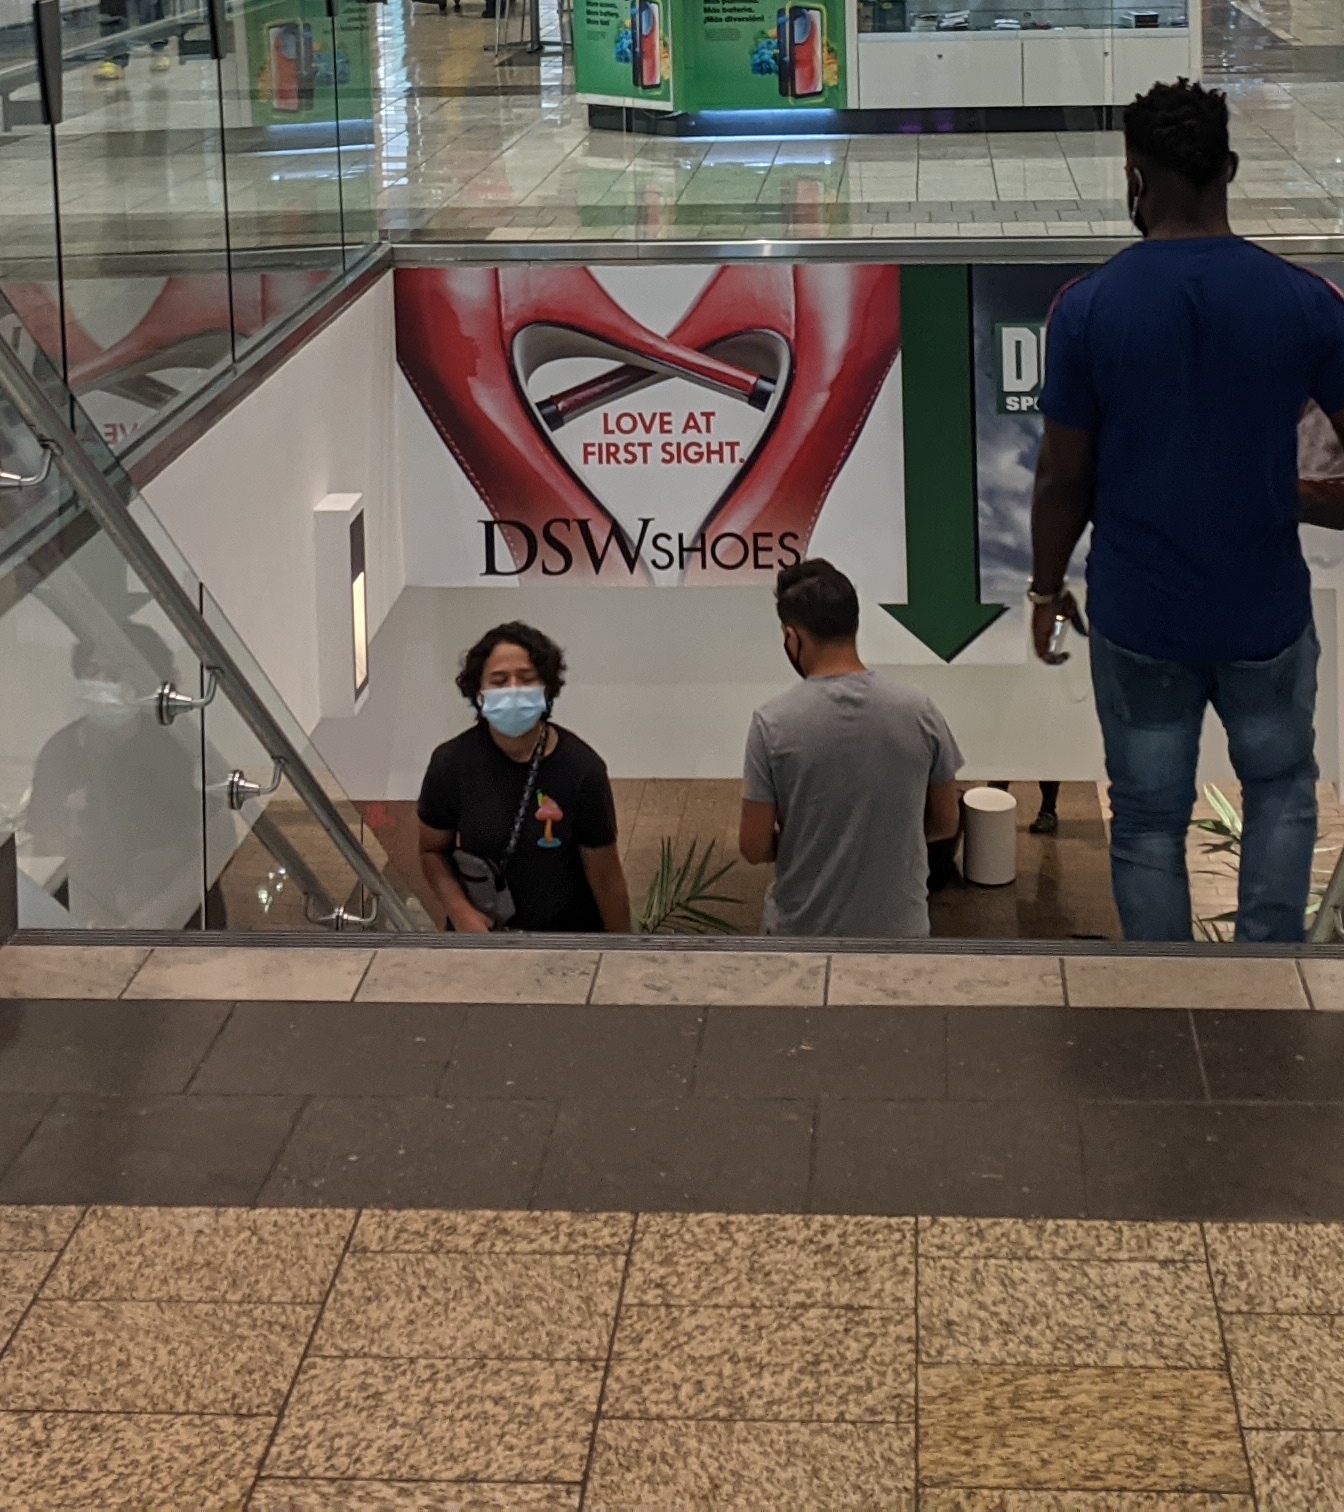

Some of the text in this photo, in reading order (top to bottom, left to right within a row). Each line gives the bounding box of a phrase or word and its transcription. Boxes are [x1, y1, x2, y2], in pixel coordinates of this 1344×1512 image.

[603, 411, 716, 435] LOVE AT
[582, 441, 746, 465] FIRST SIGHT.
[477, 517, 802, 576] DSW SHOES
